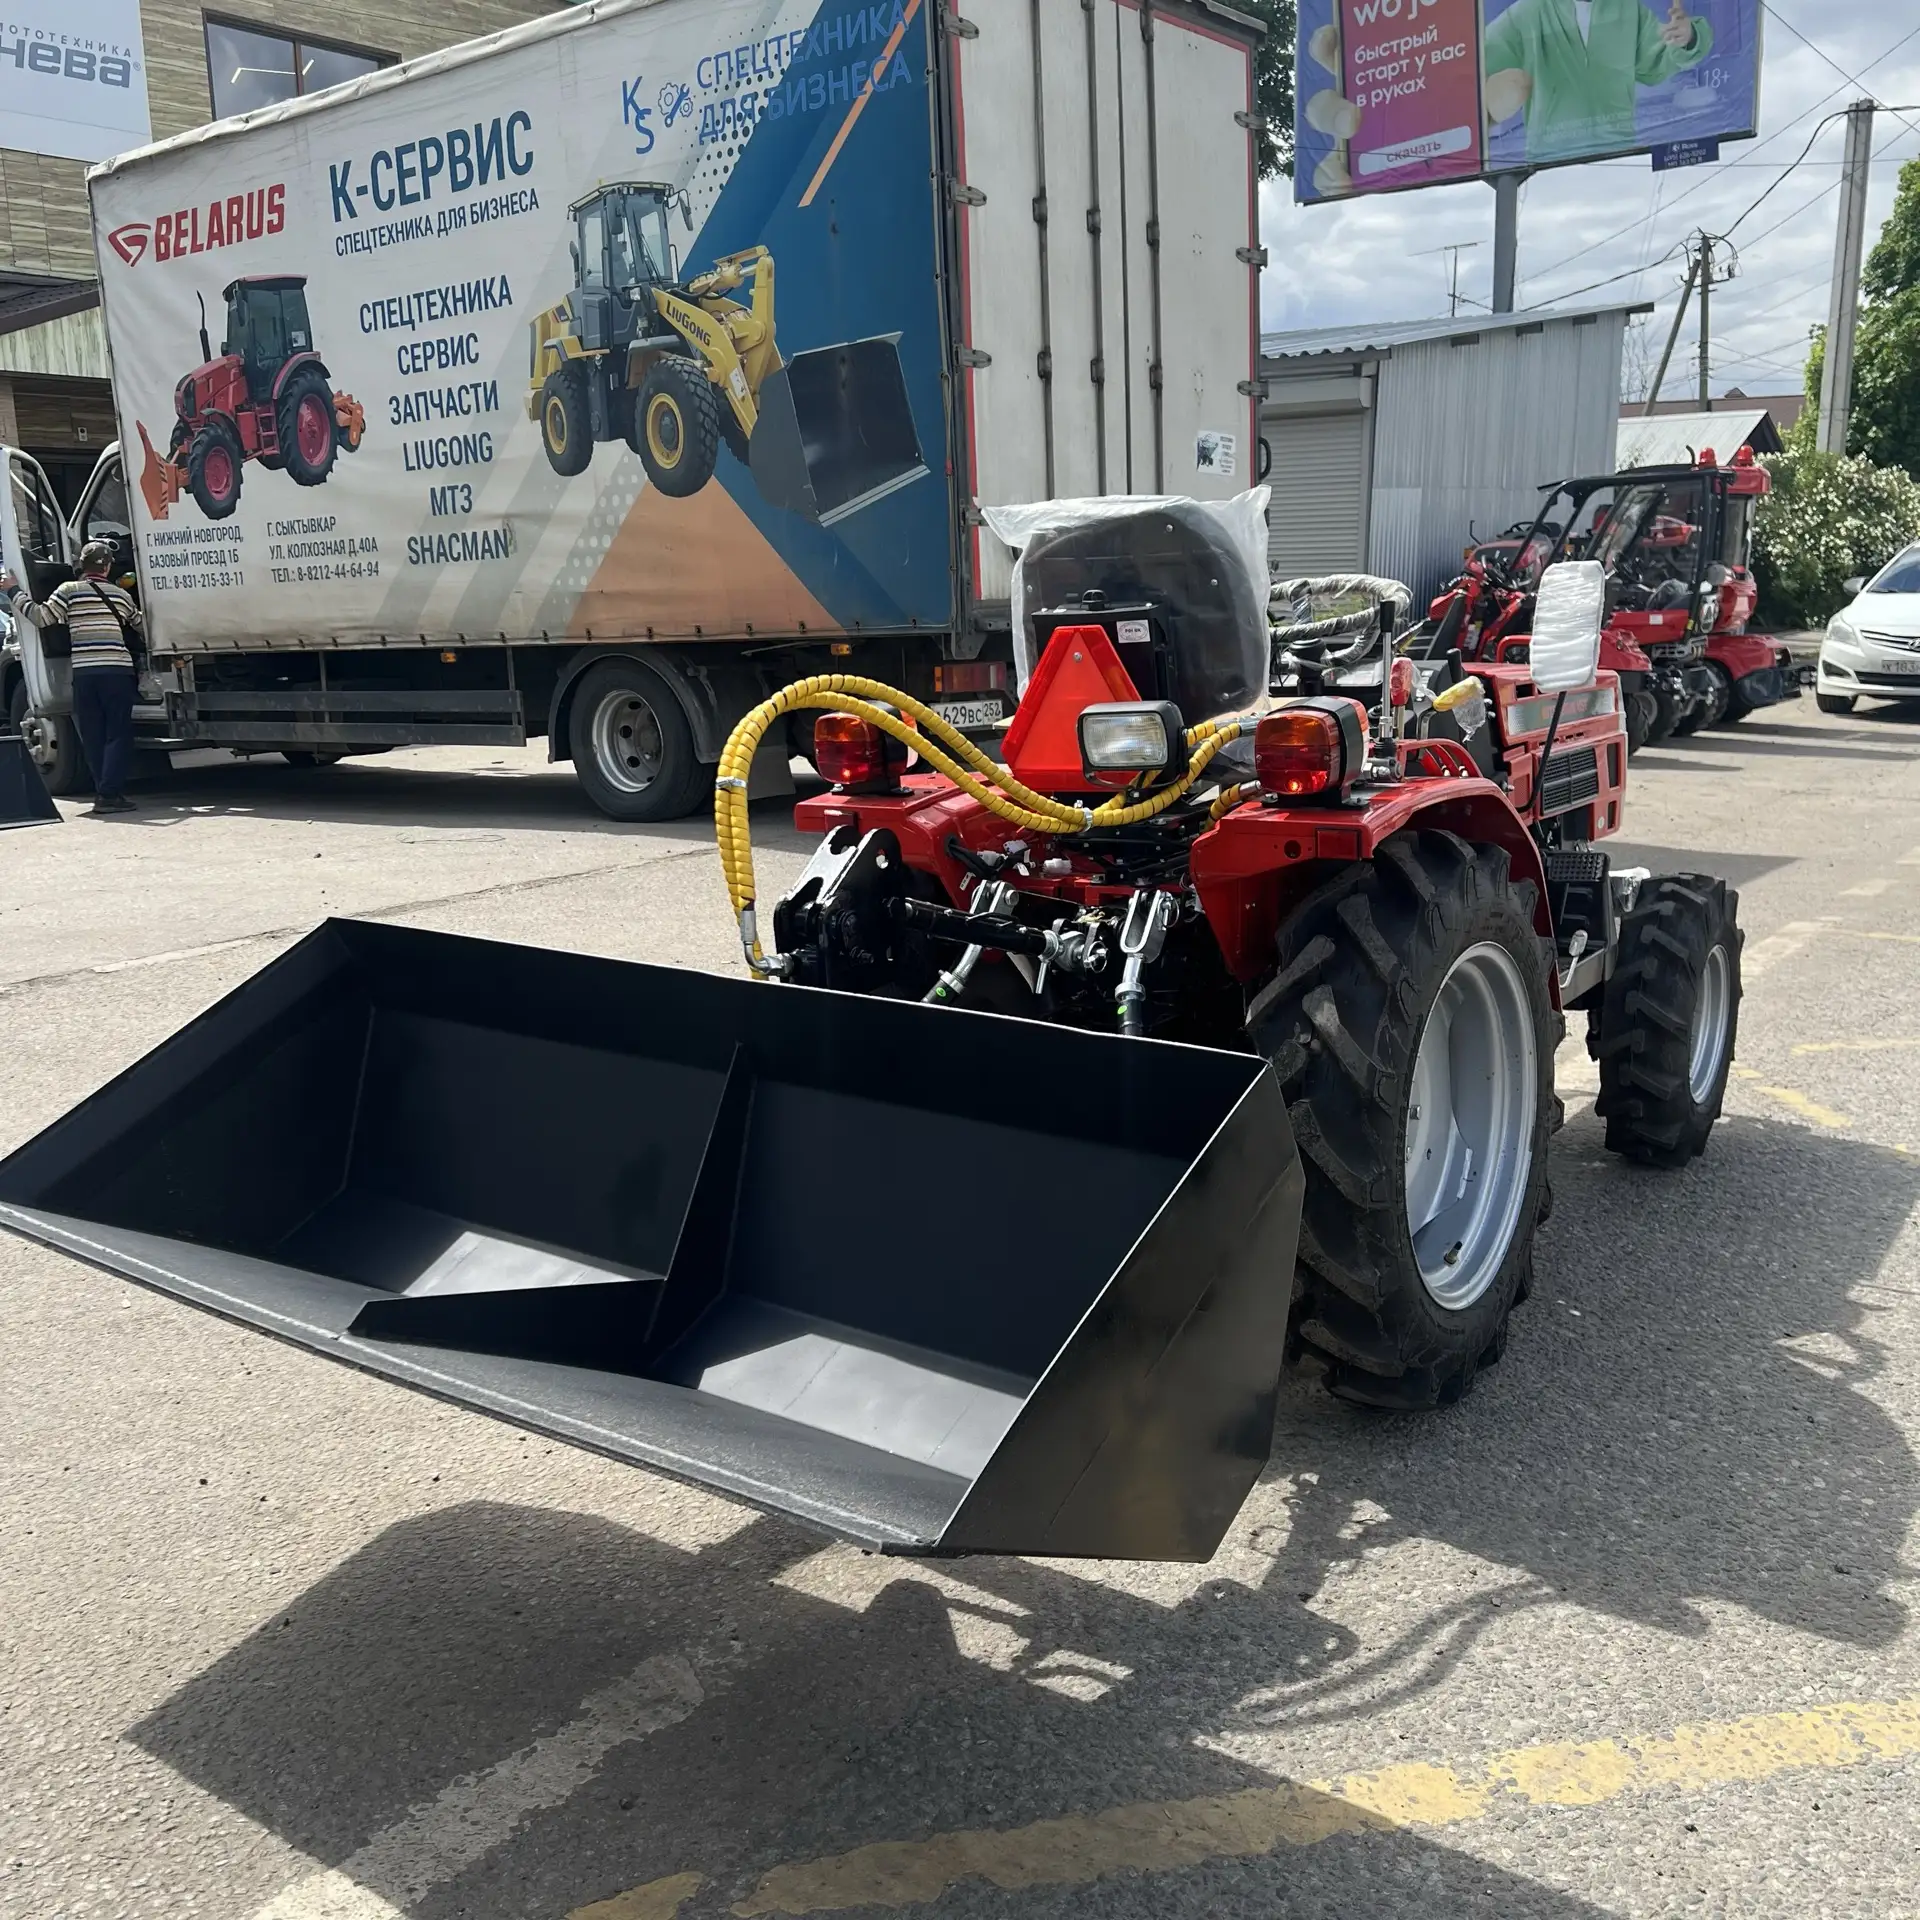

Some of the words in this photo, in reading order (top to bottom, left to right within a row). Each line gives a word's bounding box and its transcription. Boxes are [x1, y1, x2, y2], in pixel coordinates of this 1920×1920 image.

[697, 0, 910, 89] СПЕЦТЕХНИКА
[1354, 24, 1438, 64] быстрый
[1355, 59, 1410, 86] старт
[1414, 54, 1426, 73] у
[1431, 43, 1466, 65] вас
[1703, 68, 1730, 89] 18+
[699, 91, 757, 146] ДЛЯ
[768, 50, 912, 121] БИЗНЕСА
[1356, 93, 1367, 108] в
[1371, 76, 1427, 109] руках
[329, 110, 534, 222] К-СЕРВИС
[1386, 141, 1442, 163] скачать
[155, 183, 286, 263] BELARUS
[335, 214, 434, 256] СПЕЦТЕХНИКА
[437, 206, 467, 238] ДЛЯ
[470, 188, 540, 225] БИЗНЕСА
[360, 275, 513, 334] СПЕЦТЕХНИКА
[397, 332, 480, 375] СЕРВИС
[389, 380, 499, 425] ЗАПЧАСТИ
[403, 432, 493, 471] LIUGONG
[430, 484, 473, 516] МТЗ
[154, 526, 192, 547] НИЖНИЙ
[275, 516, 336, 536] СЫКТЫВКАР
[149, 549, 190, 569] БАЗОВЫЙ
[191, 549, 227, 567] ПРОЕЗД
[269, 545, 285, 560] УЛ.
[287, 539, 346, 559] КОЛХОЗНАЯ
[407, 528, 510, 565] SHACMAN
[174, 571, 244, 589] 8-831-215-33-11
[297, 561, 379, 582] 8-8212-44-64-94
